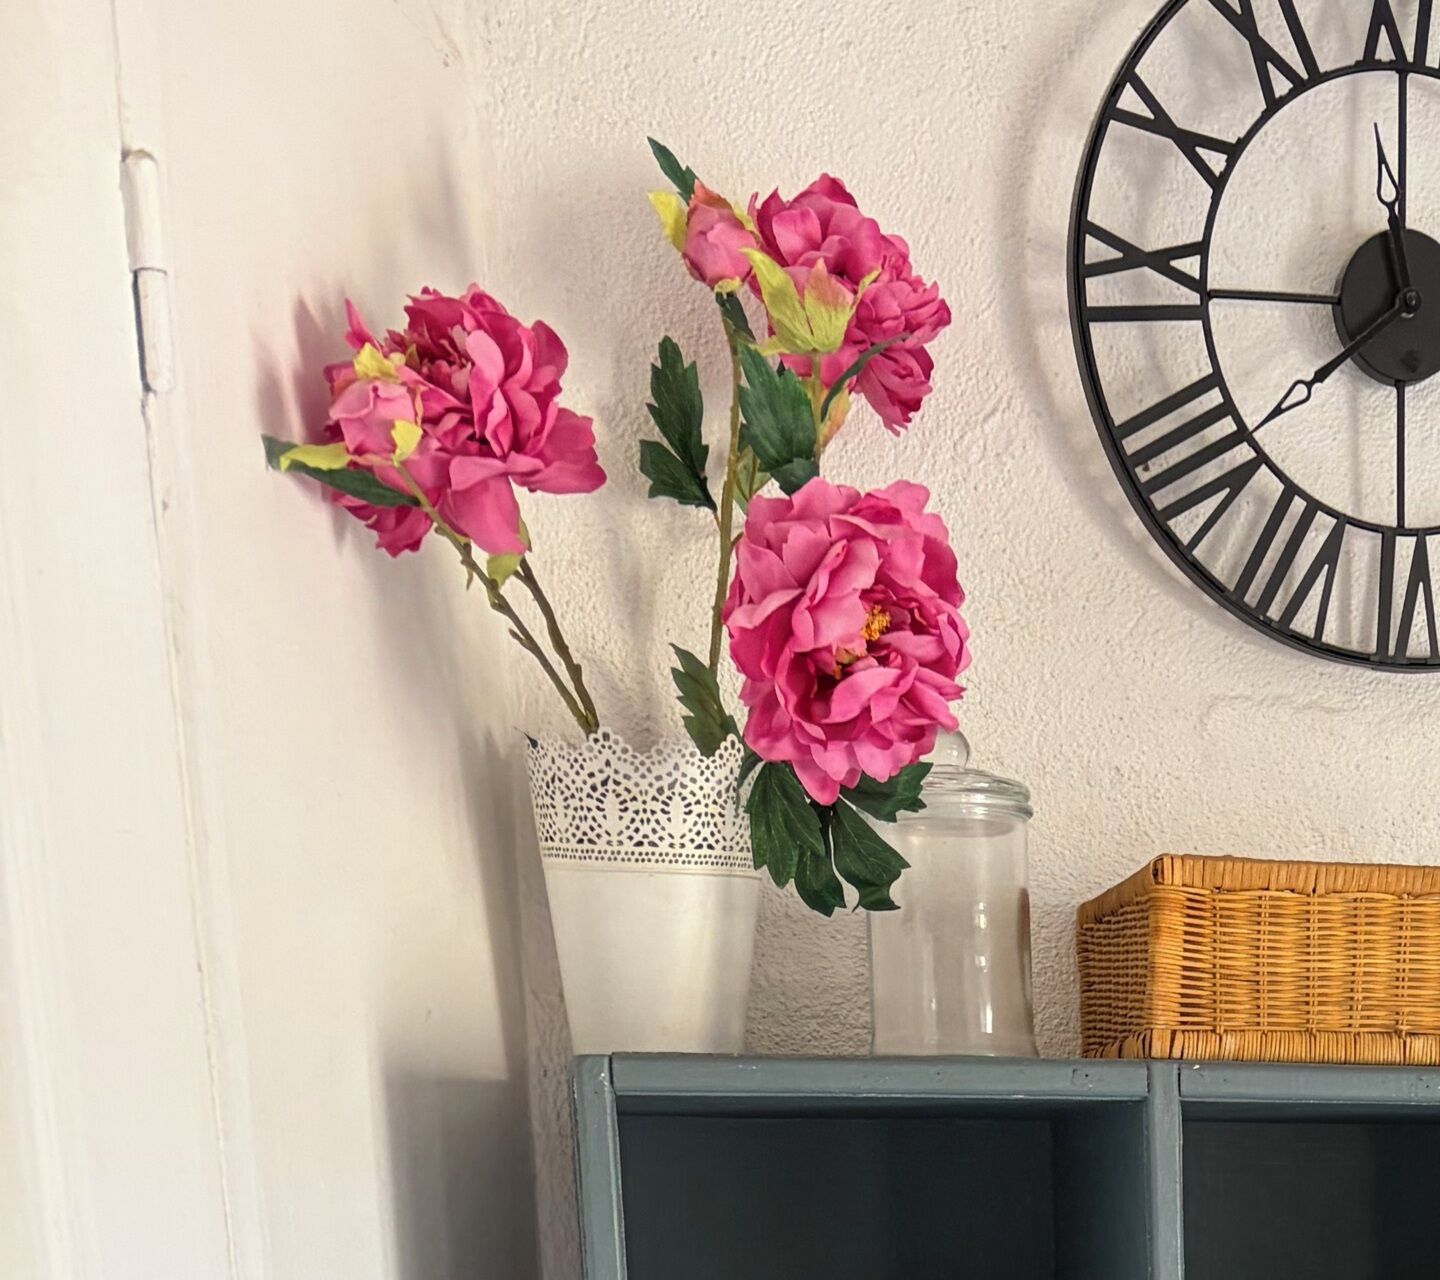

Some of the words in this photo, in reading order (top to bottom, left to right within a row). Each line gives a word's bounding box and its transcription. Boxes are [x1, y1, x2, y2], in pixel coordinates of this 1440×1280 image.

[1108, 66, 1240, 194] X
[1083, 220, 1204, 323] IX
[1114, 371, 1266, 554] VIII
[1232, 485, 1347, 645] VII
